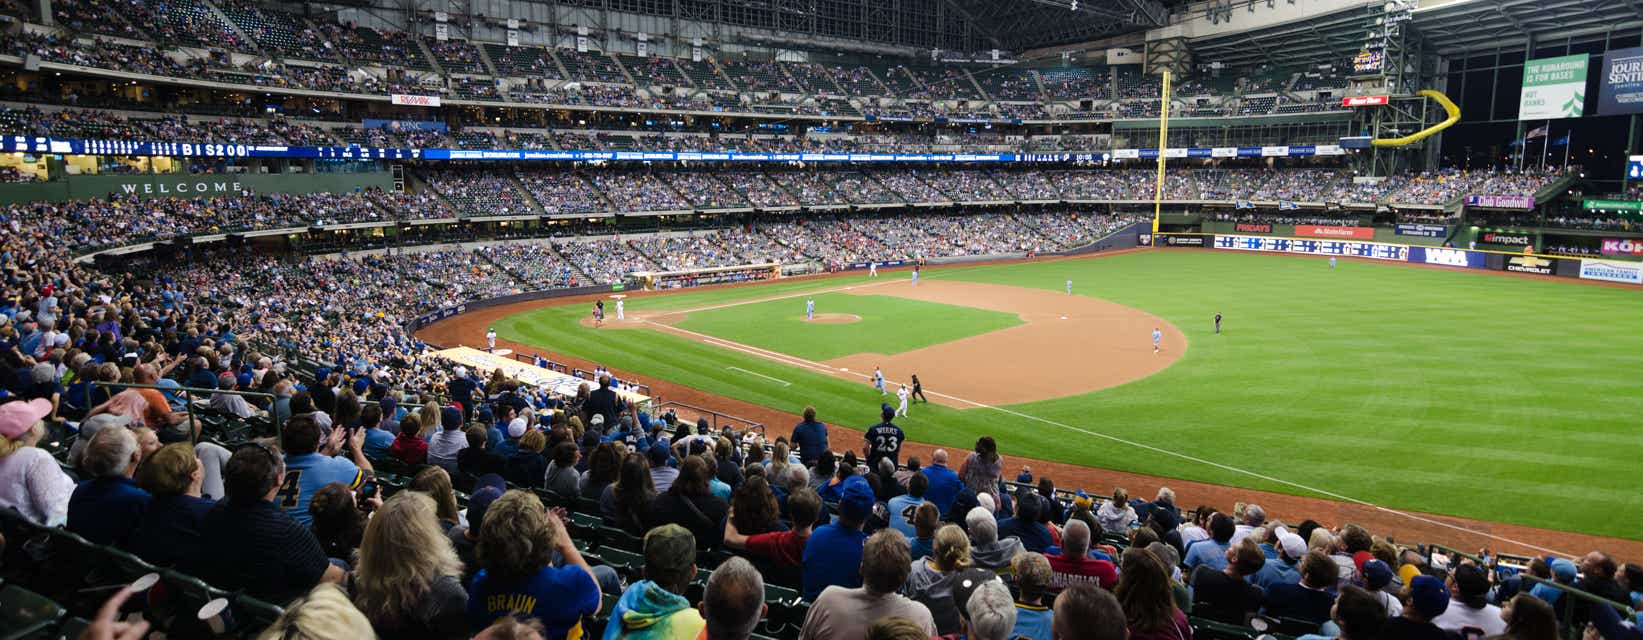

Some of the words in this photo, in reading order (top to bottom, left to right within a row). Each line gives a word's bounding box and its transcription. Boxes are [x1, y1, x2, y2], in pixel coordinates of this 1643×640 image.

[1527, 65, 1539, 74] THE
[1611, 61, 1643, 75] JOUR
[1526, 75, 1533, 83] IS
[1535, 73, 1549, 82] FOR
[1608, 72, 1643, 84] SENTI
[401, 121, 422, 130] PNC
[121, 182, 242, 194] WELCOME
[1478, 195, 1494, 207] Club
[1496, 196, 1529, 209] Goodwill
[1507, 265, 1552, 274] CHEVROLET
[876, 435, 898, 452] 23
[279, 469, 303, 510] 4
[487, 593, 537, 615] BRAUN
